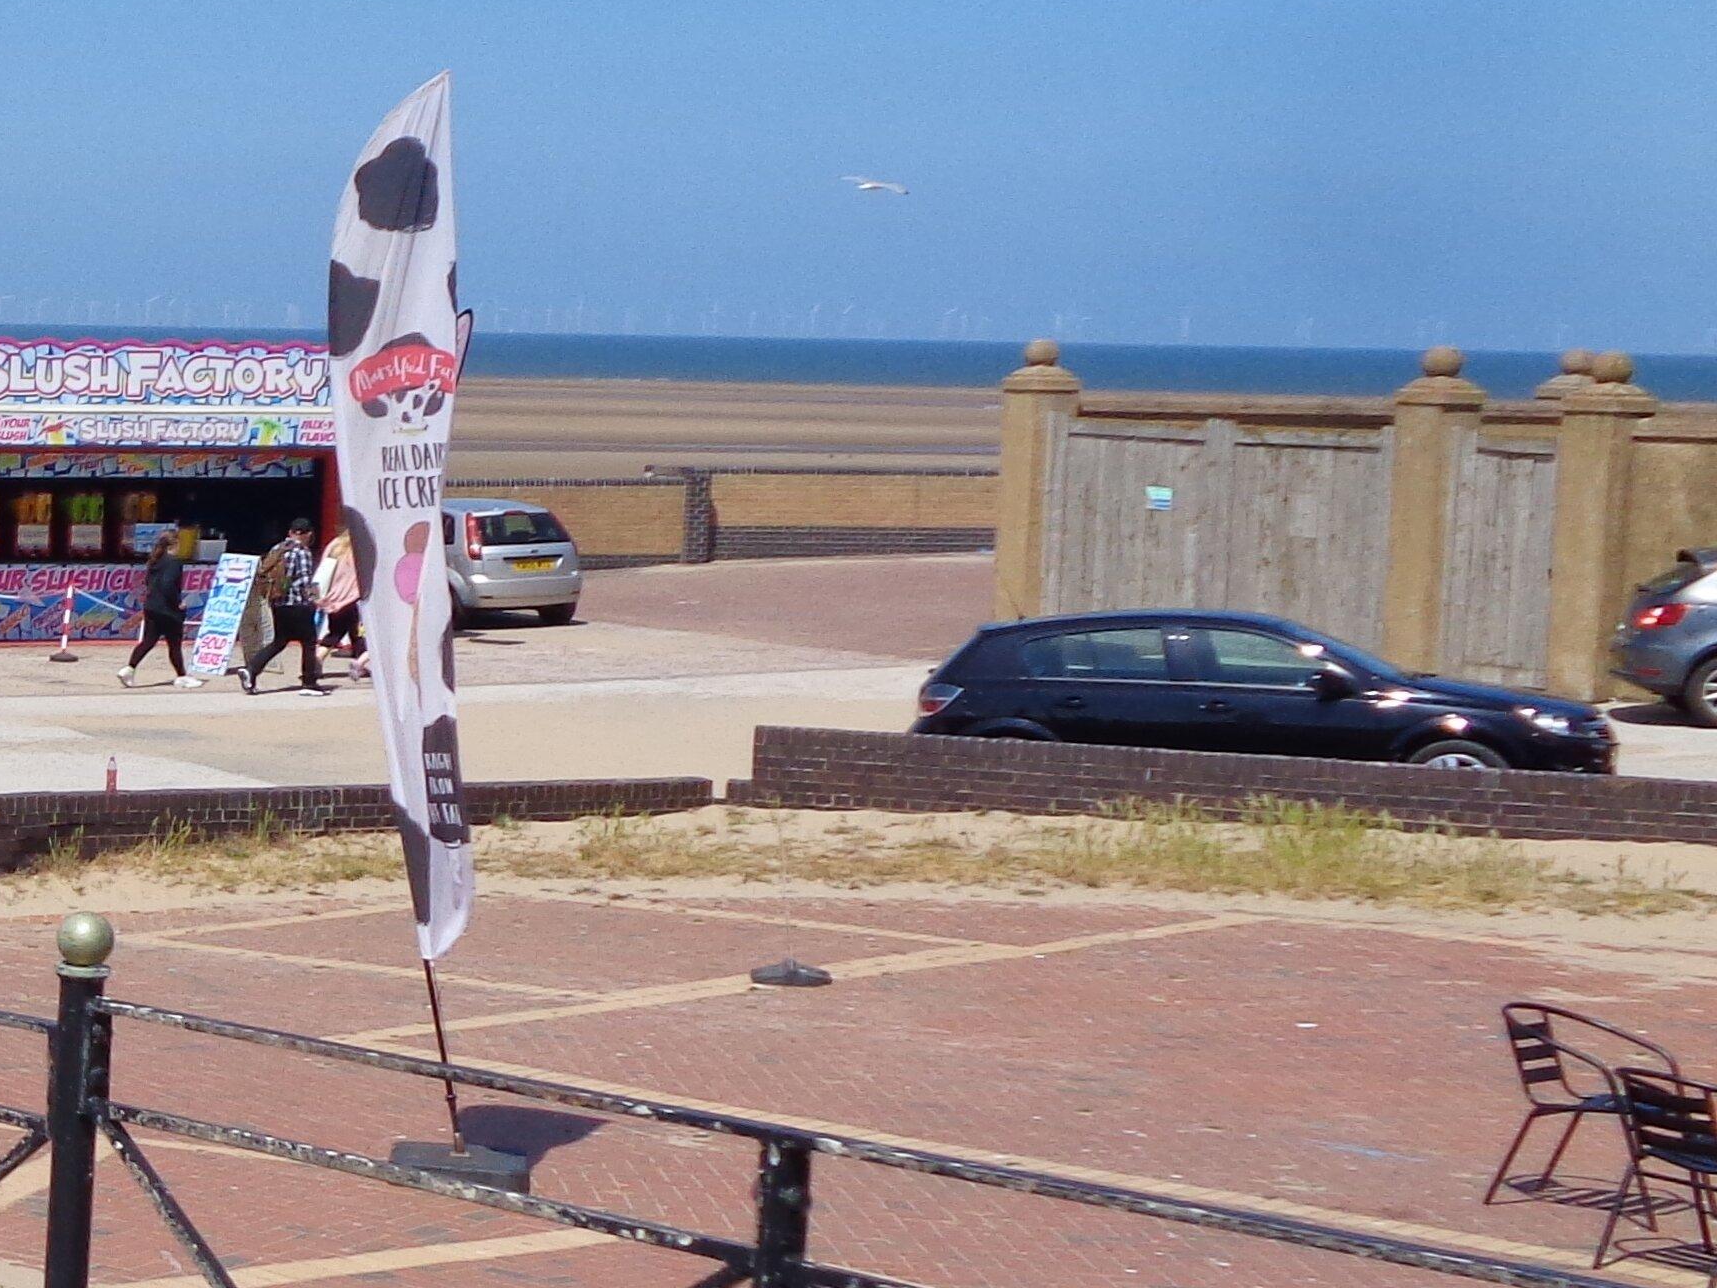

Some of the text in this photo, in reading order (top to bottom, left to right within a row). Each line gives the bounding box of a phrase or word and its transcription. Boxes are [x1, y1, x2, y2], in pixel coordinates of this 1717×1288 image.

[126, 350, 328, 400] FACTORY
[5, 418, 30, 427] YOUR
[78, 417, 247, 441] SLUSH FACTORY
[381, 446, 409, 473] REAL
[378, 474, 440, 510] ICE CRE
[31, 569, 105, 591] SLUSH
[202, 636, 228, 650] SOLD
[197, 653, 223, 666] HERE
